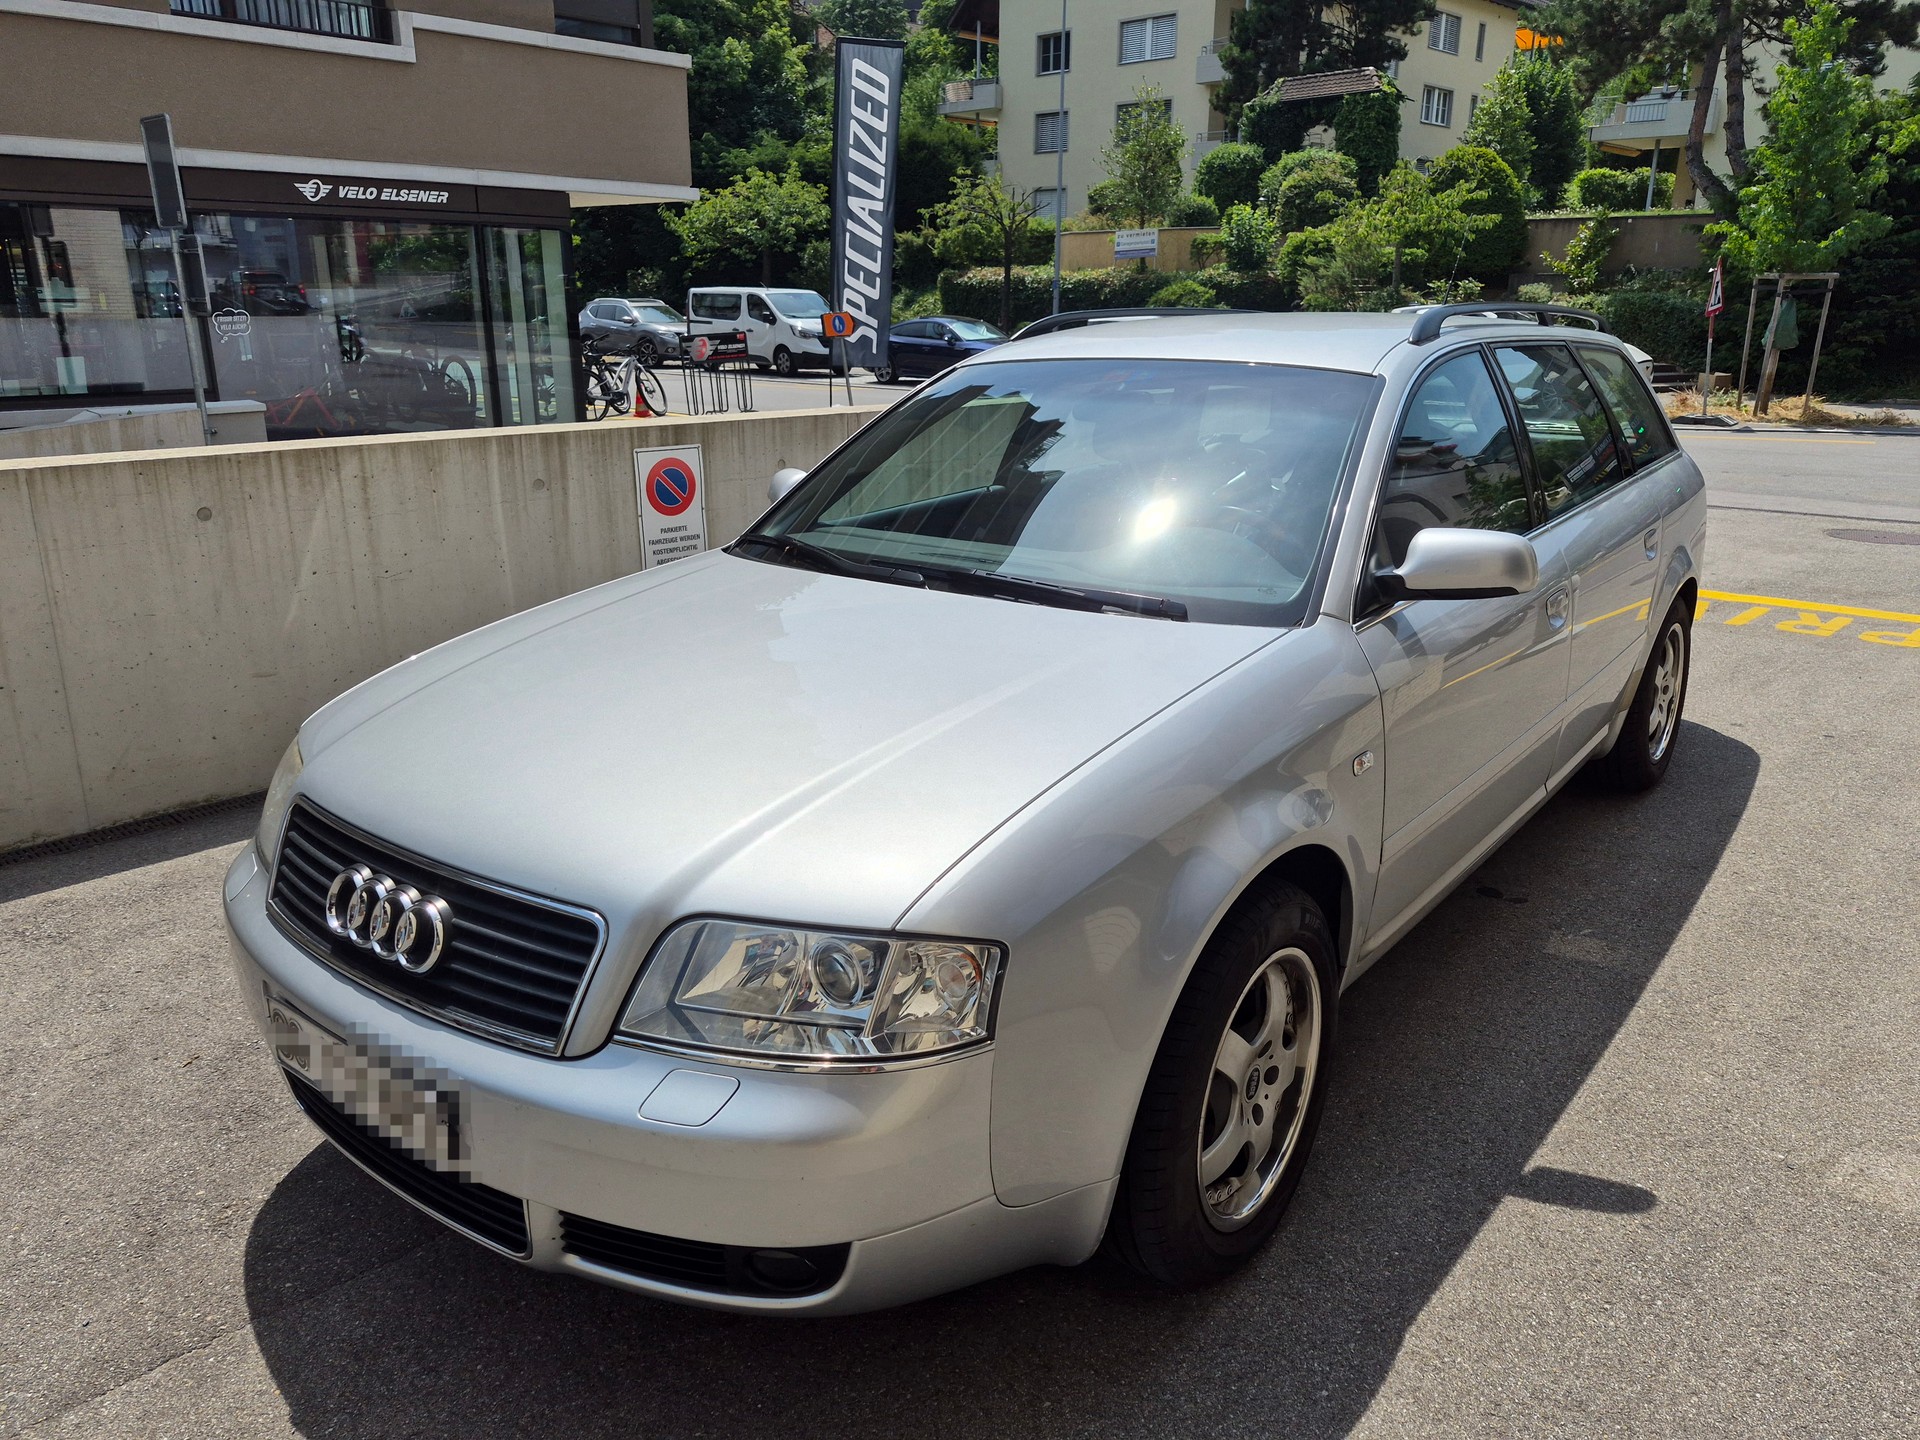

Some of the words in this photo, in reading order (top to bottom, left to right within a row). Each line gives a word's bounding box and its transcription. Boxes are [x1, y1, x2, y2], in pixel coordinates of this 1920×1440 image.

[338, 185, 378, 200] VELO
[380, 188, 449, 204] ELSENER
[843, 57, 890, 354] SPECIALIZED
[660, 525, 688, 534] PARKIERTE
[648, 536, 678, 546] FAHRZEUGE
[679, 533, 701, 542] WERDEN
[652, 544, 699, 556] KOSTENPFLICHTIG
